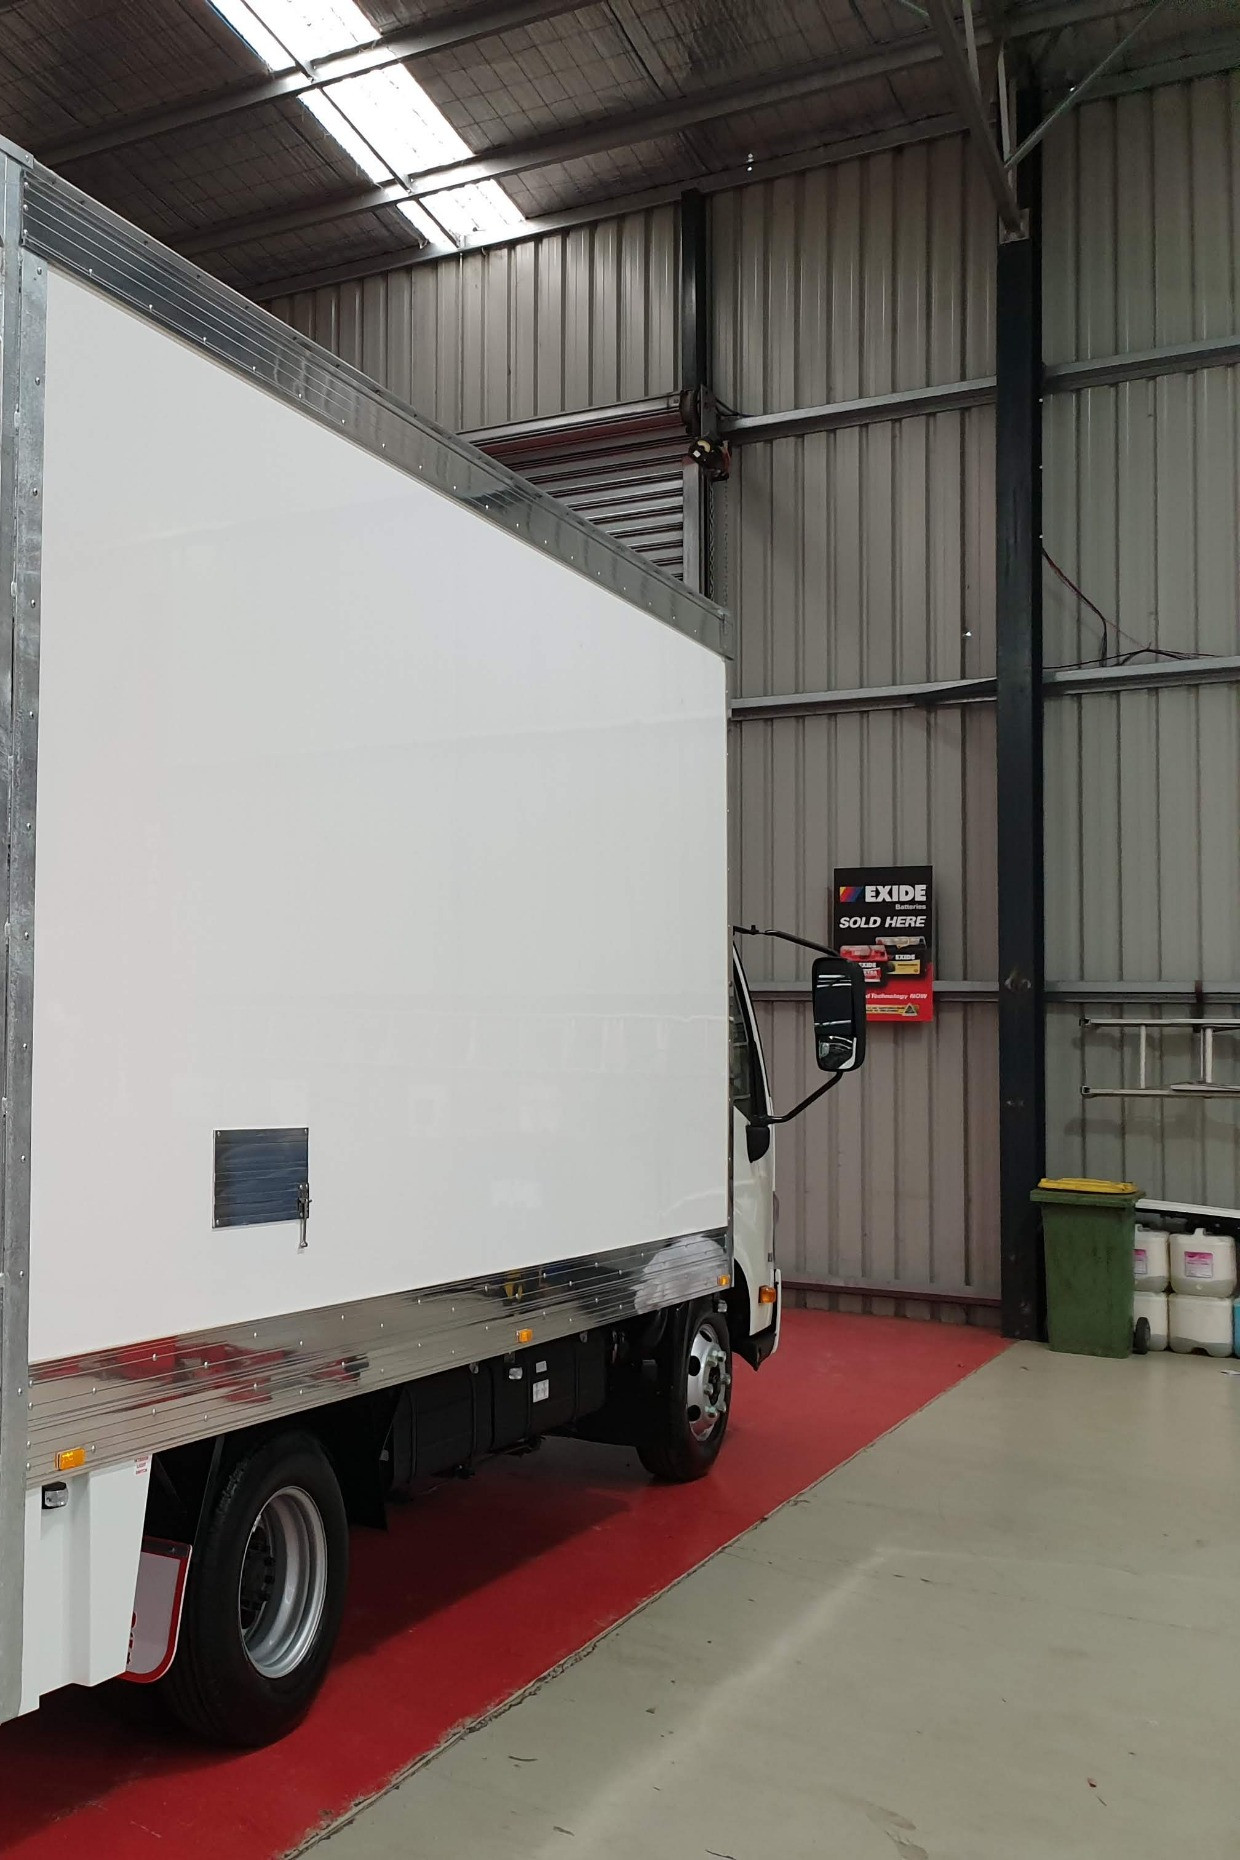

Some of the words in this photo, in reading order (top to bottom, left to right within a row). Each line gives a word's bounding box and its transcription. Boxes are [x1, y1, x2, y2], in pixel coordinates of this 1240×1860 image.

[865, 885, 927, 902] EXIDE
[839, 916, 881, 928] SOLD
[885, 916, 926, 927] HERE
